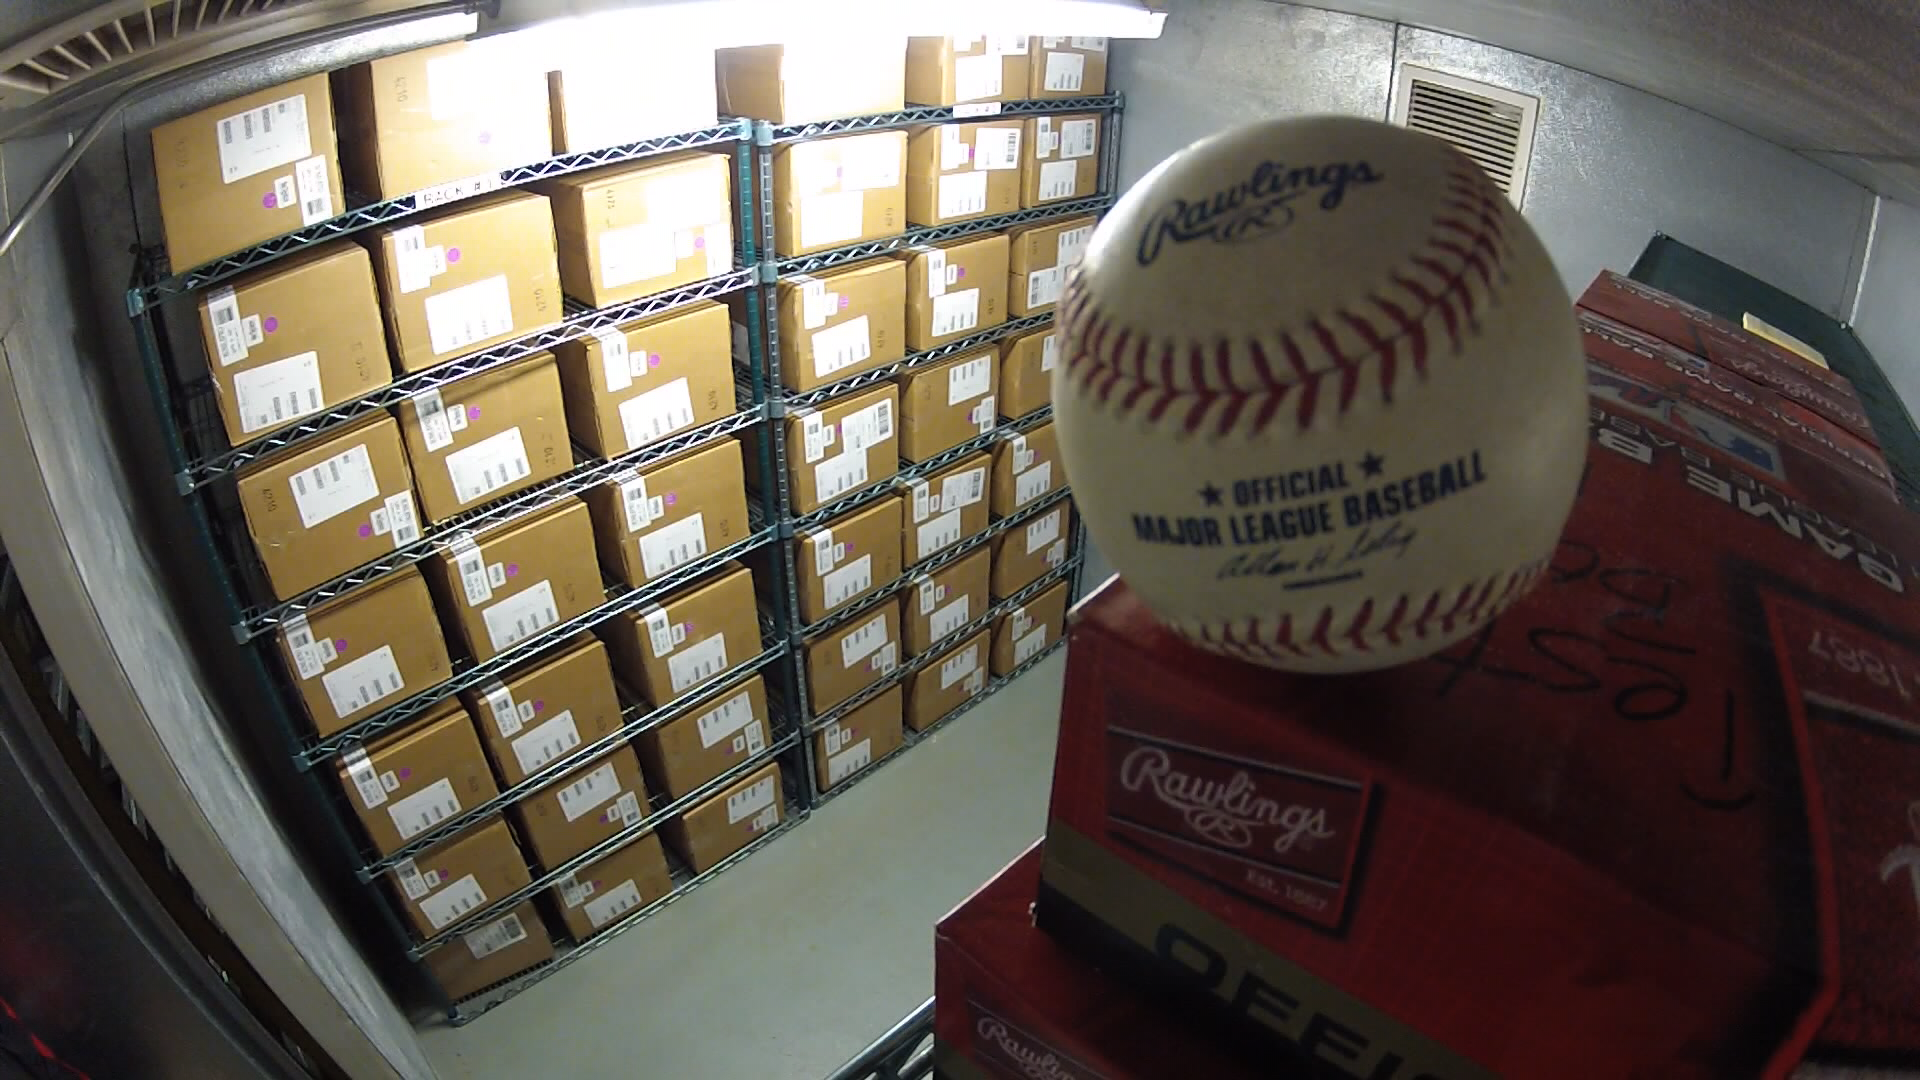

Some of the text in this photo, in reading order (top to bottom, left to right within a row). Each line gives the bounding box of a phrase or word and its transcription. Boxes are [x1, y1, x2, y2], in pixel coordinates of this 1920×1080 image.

[1137, 160, 1382, 267] Rawlings
[1132, 449, 1488, 547] MAJOR LEAGUE BASEBALL
[1233, 461, 1350, 507] OFFICIAL
[1685, 464, 1905, 594] GAME
[1808, 629, 1911, 701] 1887
[1120, 745, 1337, 854] Rawlings
